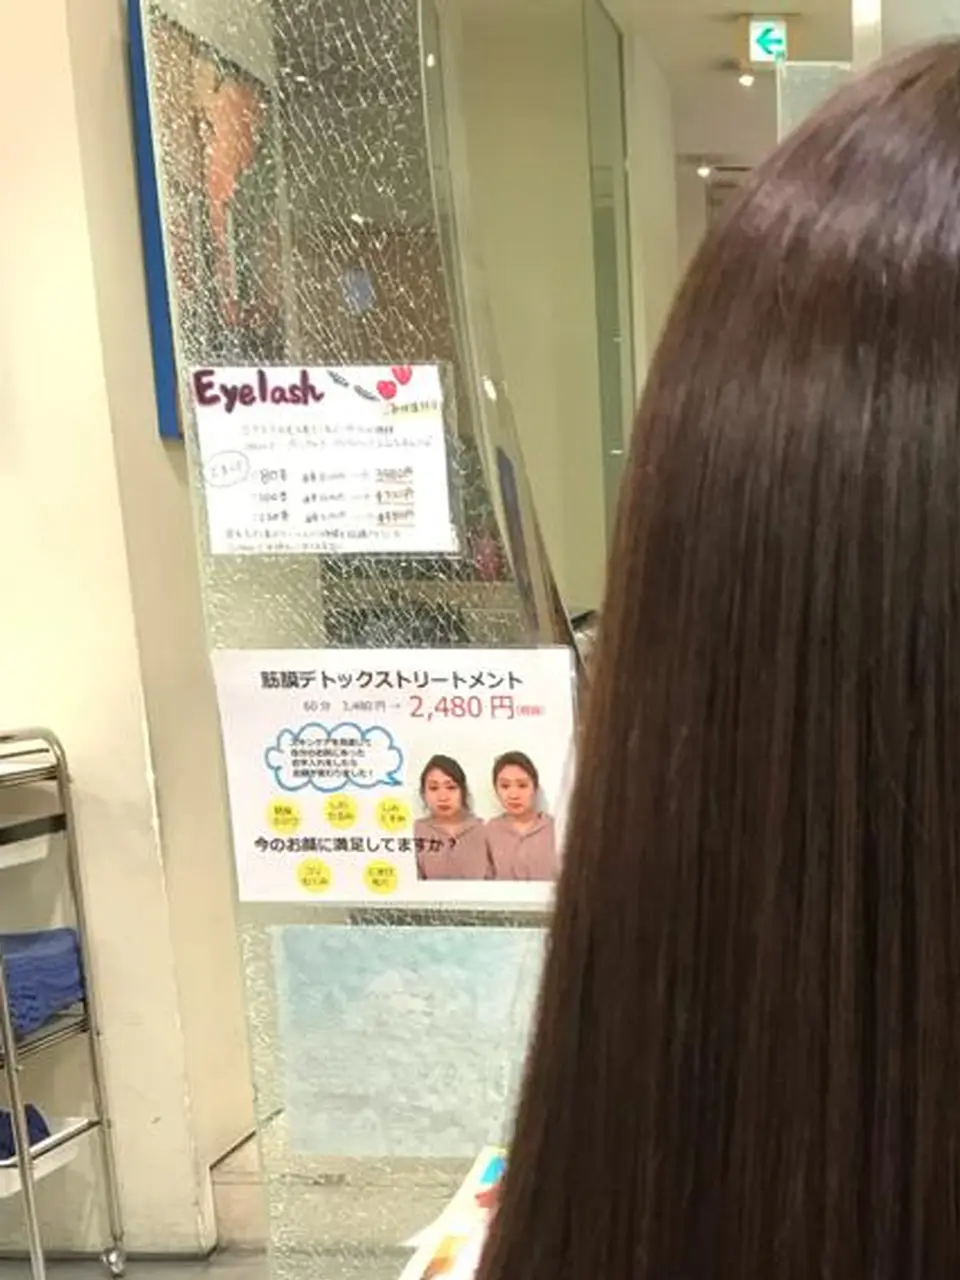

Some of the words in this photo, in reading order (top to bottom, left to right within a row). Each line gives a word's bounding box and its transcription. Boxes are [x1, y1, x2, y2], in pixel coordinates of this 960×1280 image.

[193, 369, 324, 413] Eyelash
[260, 670, 524, 689] 筋膜デトックストリートメント
